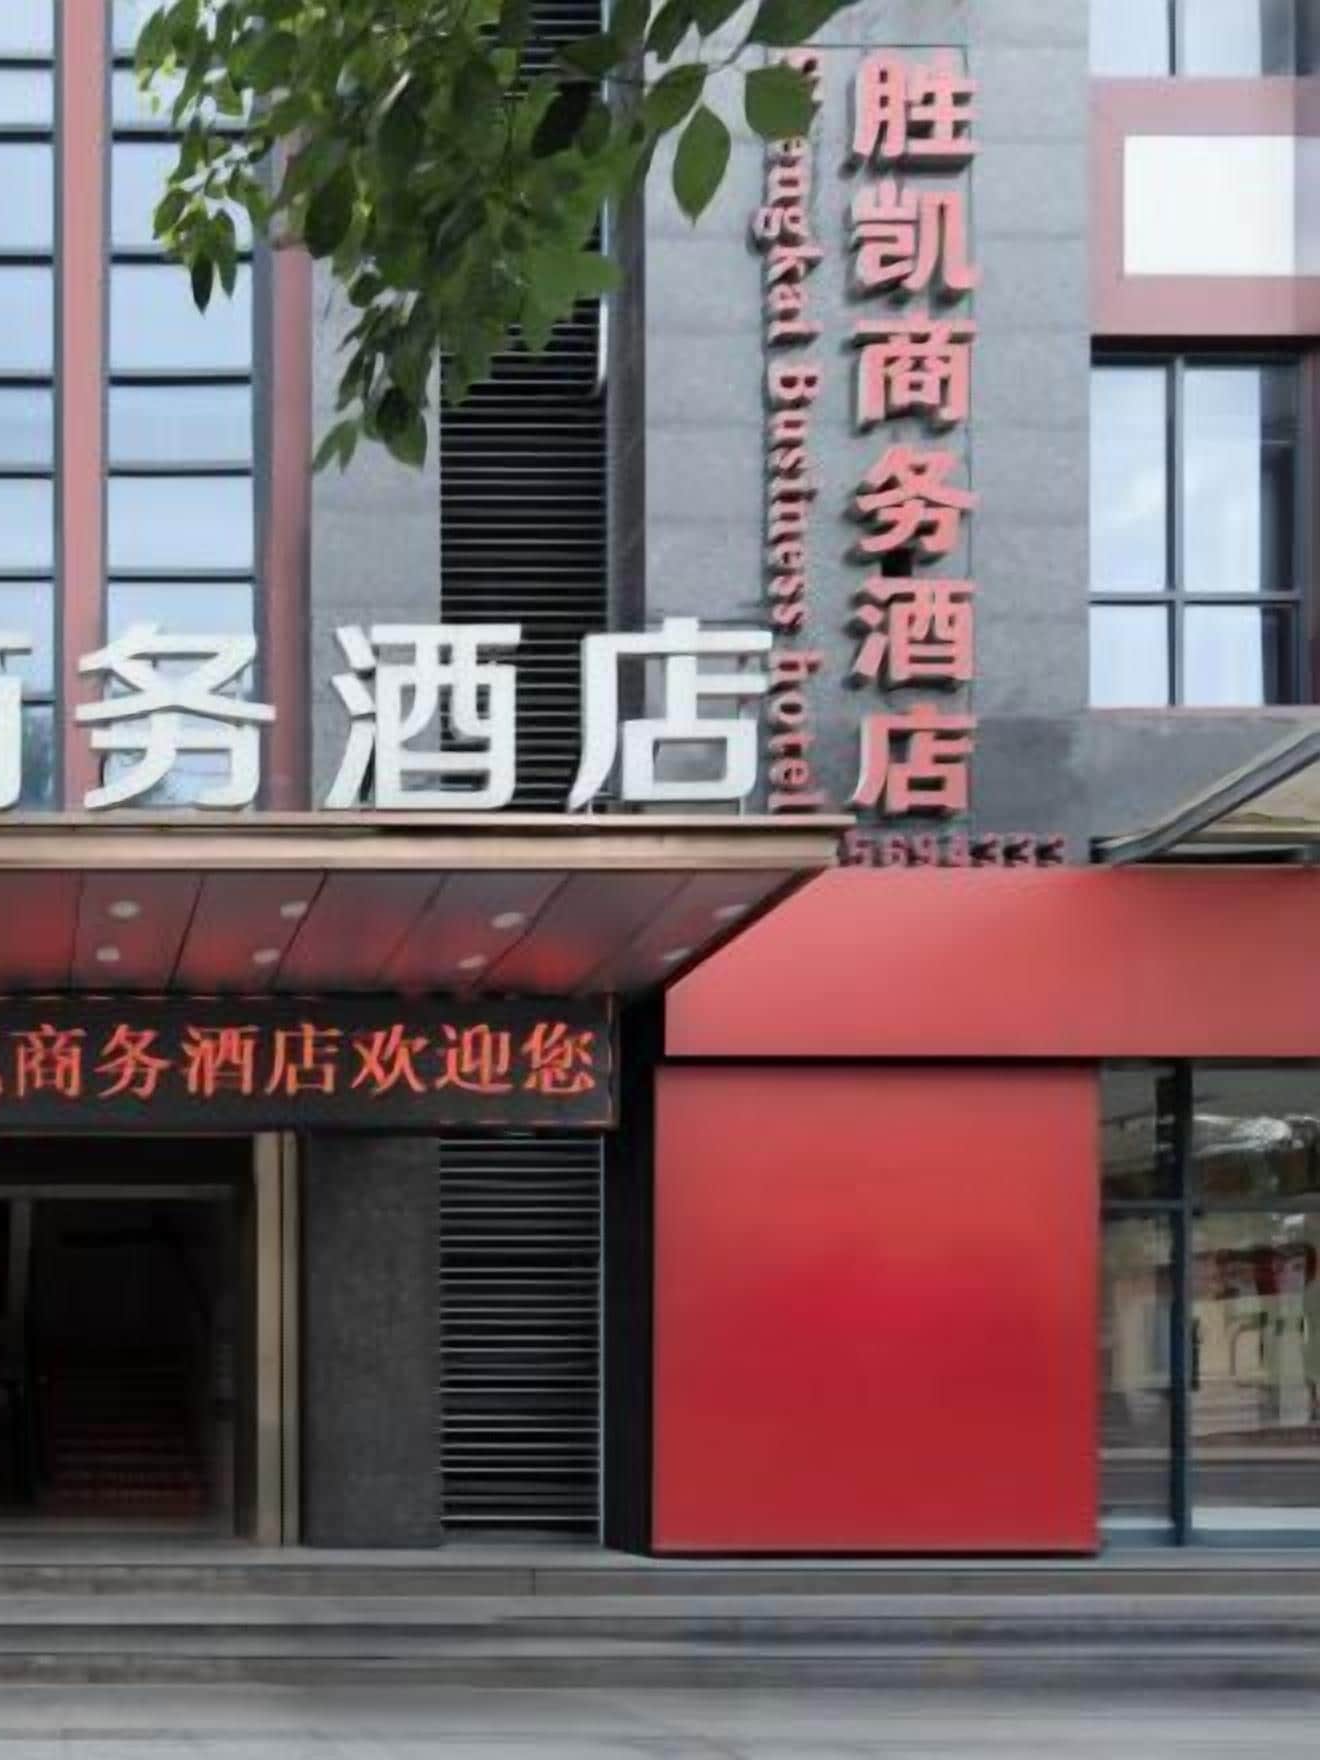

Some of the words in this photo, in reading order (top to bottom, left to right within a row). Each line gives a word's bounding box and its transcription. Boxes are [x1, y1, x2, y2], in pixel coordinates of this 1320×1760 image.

[768, 358, 824, 630] Business
[850, 50, 977, 814] 胜凯商务酒店
[768, 648, 827, 813] hotel
